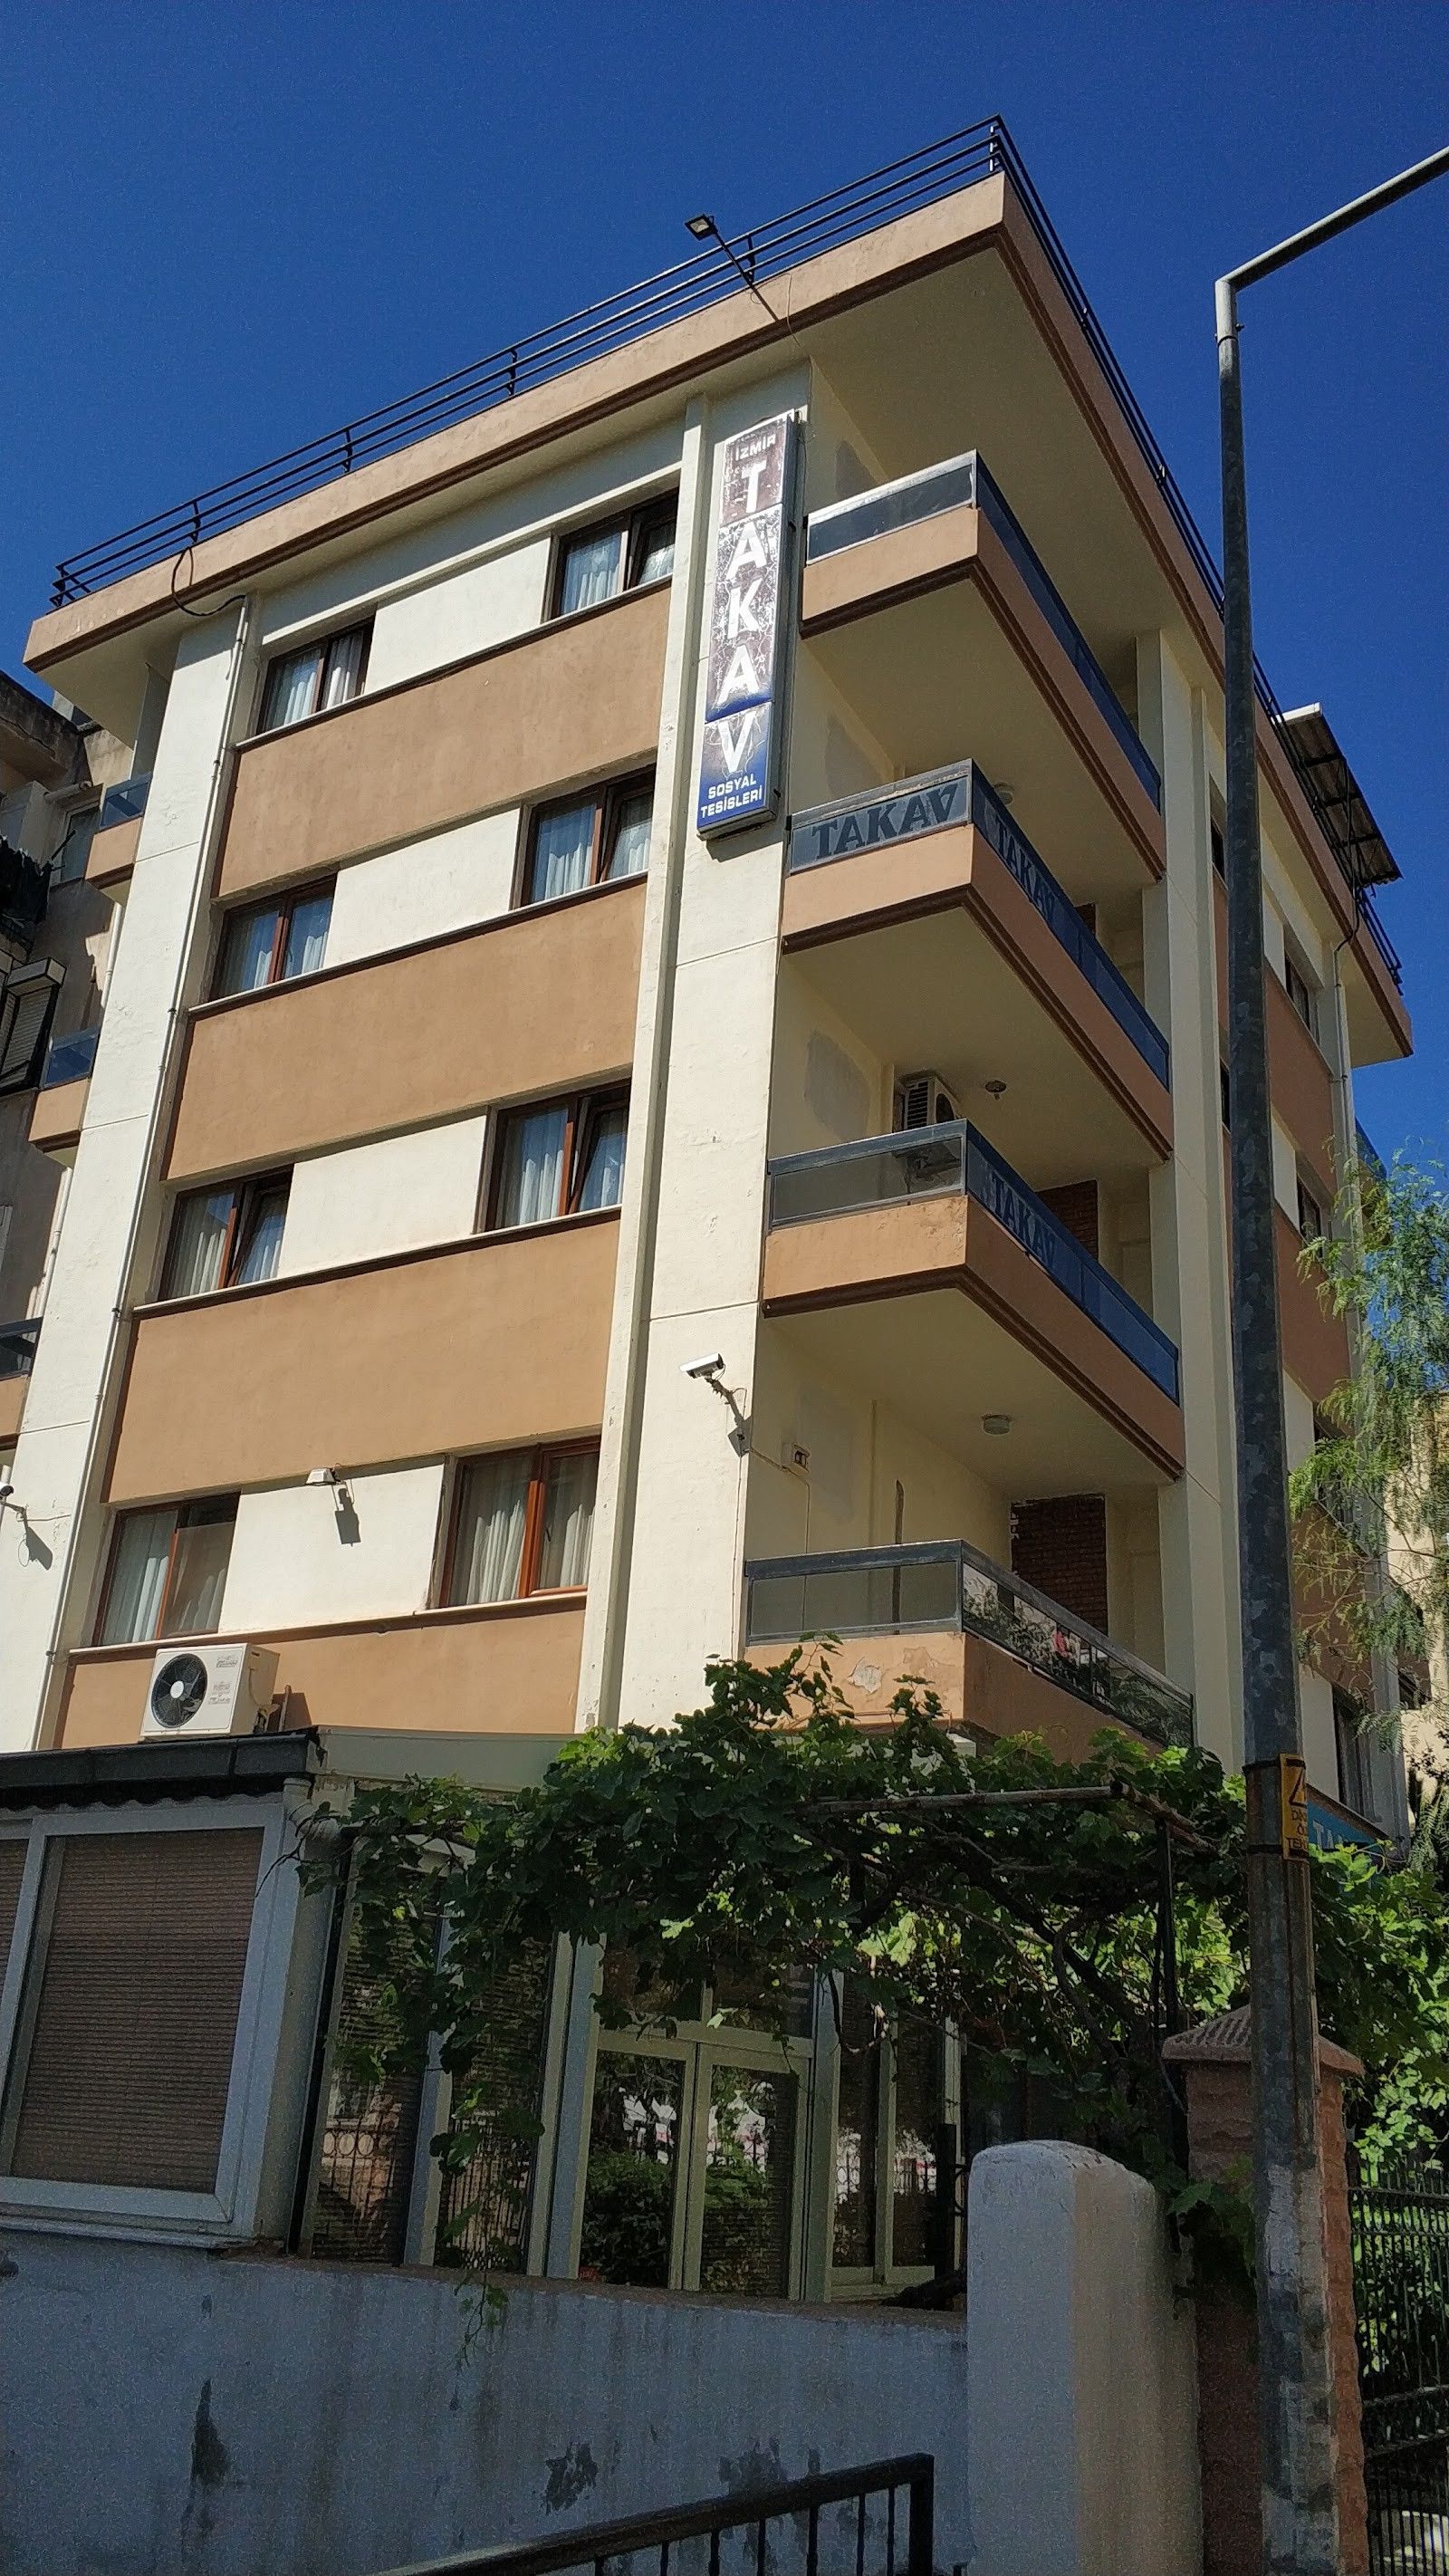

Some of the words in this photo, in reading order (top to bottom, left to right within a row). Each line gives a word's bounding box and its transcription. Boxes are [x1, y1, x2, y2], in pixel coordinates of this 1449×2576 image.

[716, 459, 768, 774] TAKAV
[700, 784, 763, 818] TESİSLERİ
[708, 773, 757, 799] SOSYAL
[811, 783, 959, 860] TAKAV
